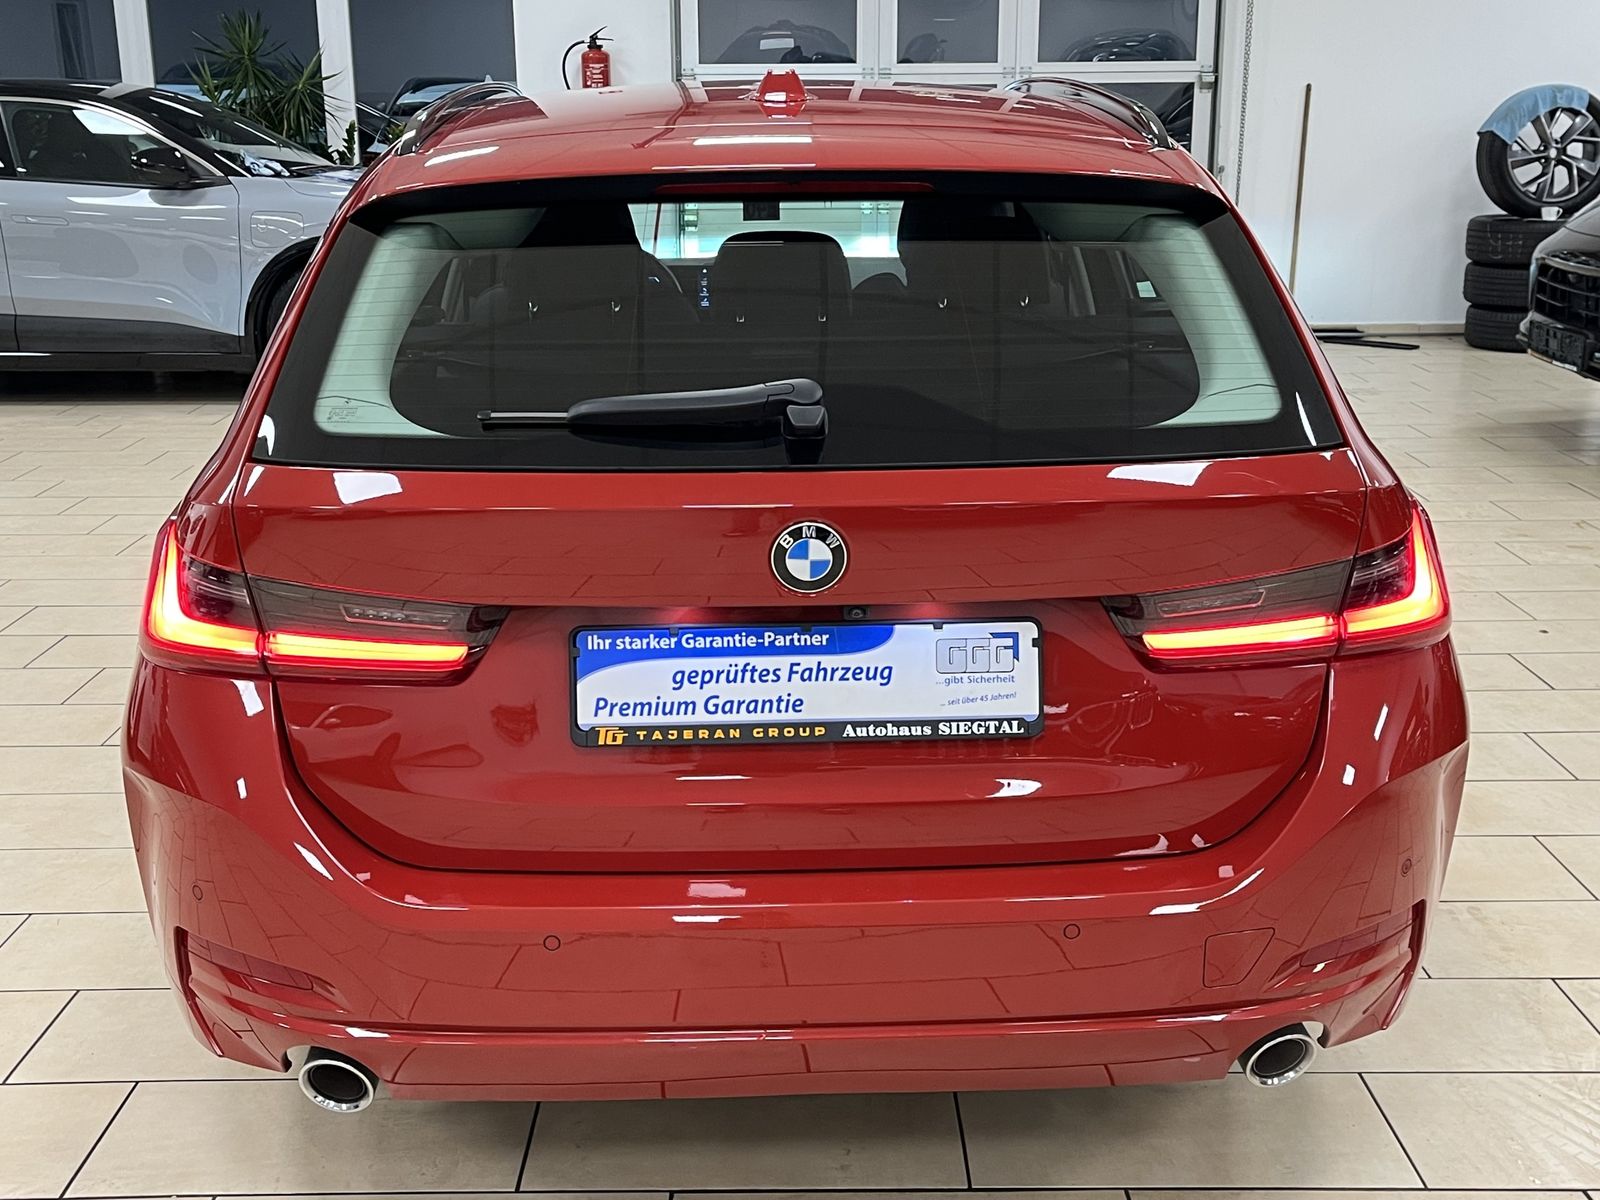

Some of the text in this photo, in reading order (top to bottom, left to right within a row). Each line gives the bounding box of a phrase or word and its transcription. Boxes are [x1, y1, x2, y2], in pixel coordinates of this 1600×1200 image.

[779, 525, 840, 549] BMW
[587, 632, 830, 650] Ihr starker Garantie-Partner
[936, 636, 1016, 674] GGG
[672, 661, 894, 690] geprüftes Fahrzeug
[967, 674, 1016, 685] Sicherheit
[593, 693, 804, 717] Premium Garantie
[947, 697, 961, 706] seit
[961, 695, 979, 705] über
[979, 693, 990, 702] 45
[991, 691, 1017, 702] Jahren!
[636, 728, 741, 741] TAJERAN
[752, 726, 826, 738] GROUP
[842, 720, 1025, 738] Autohaus SIEGTAL
